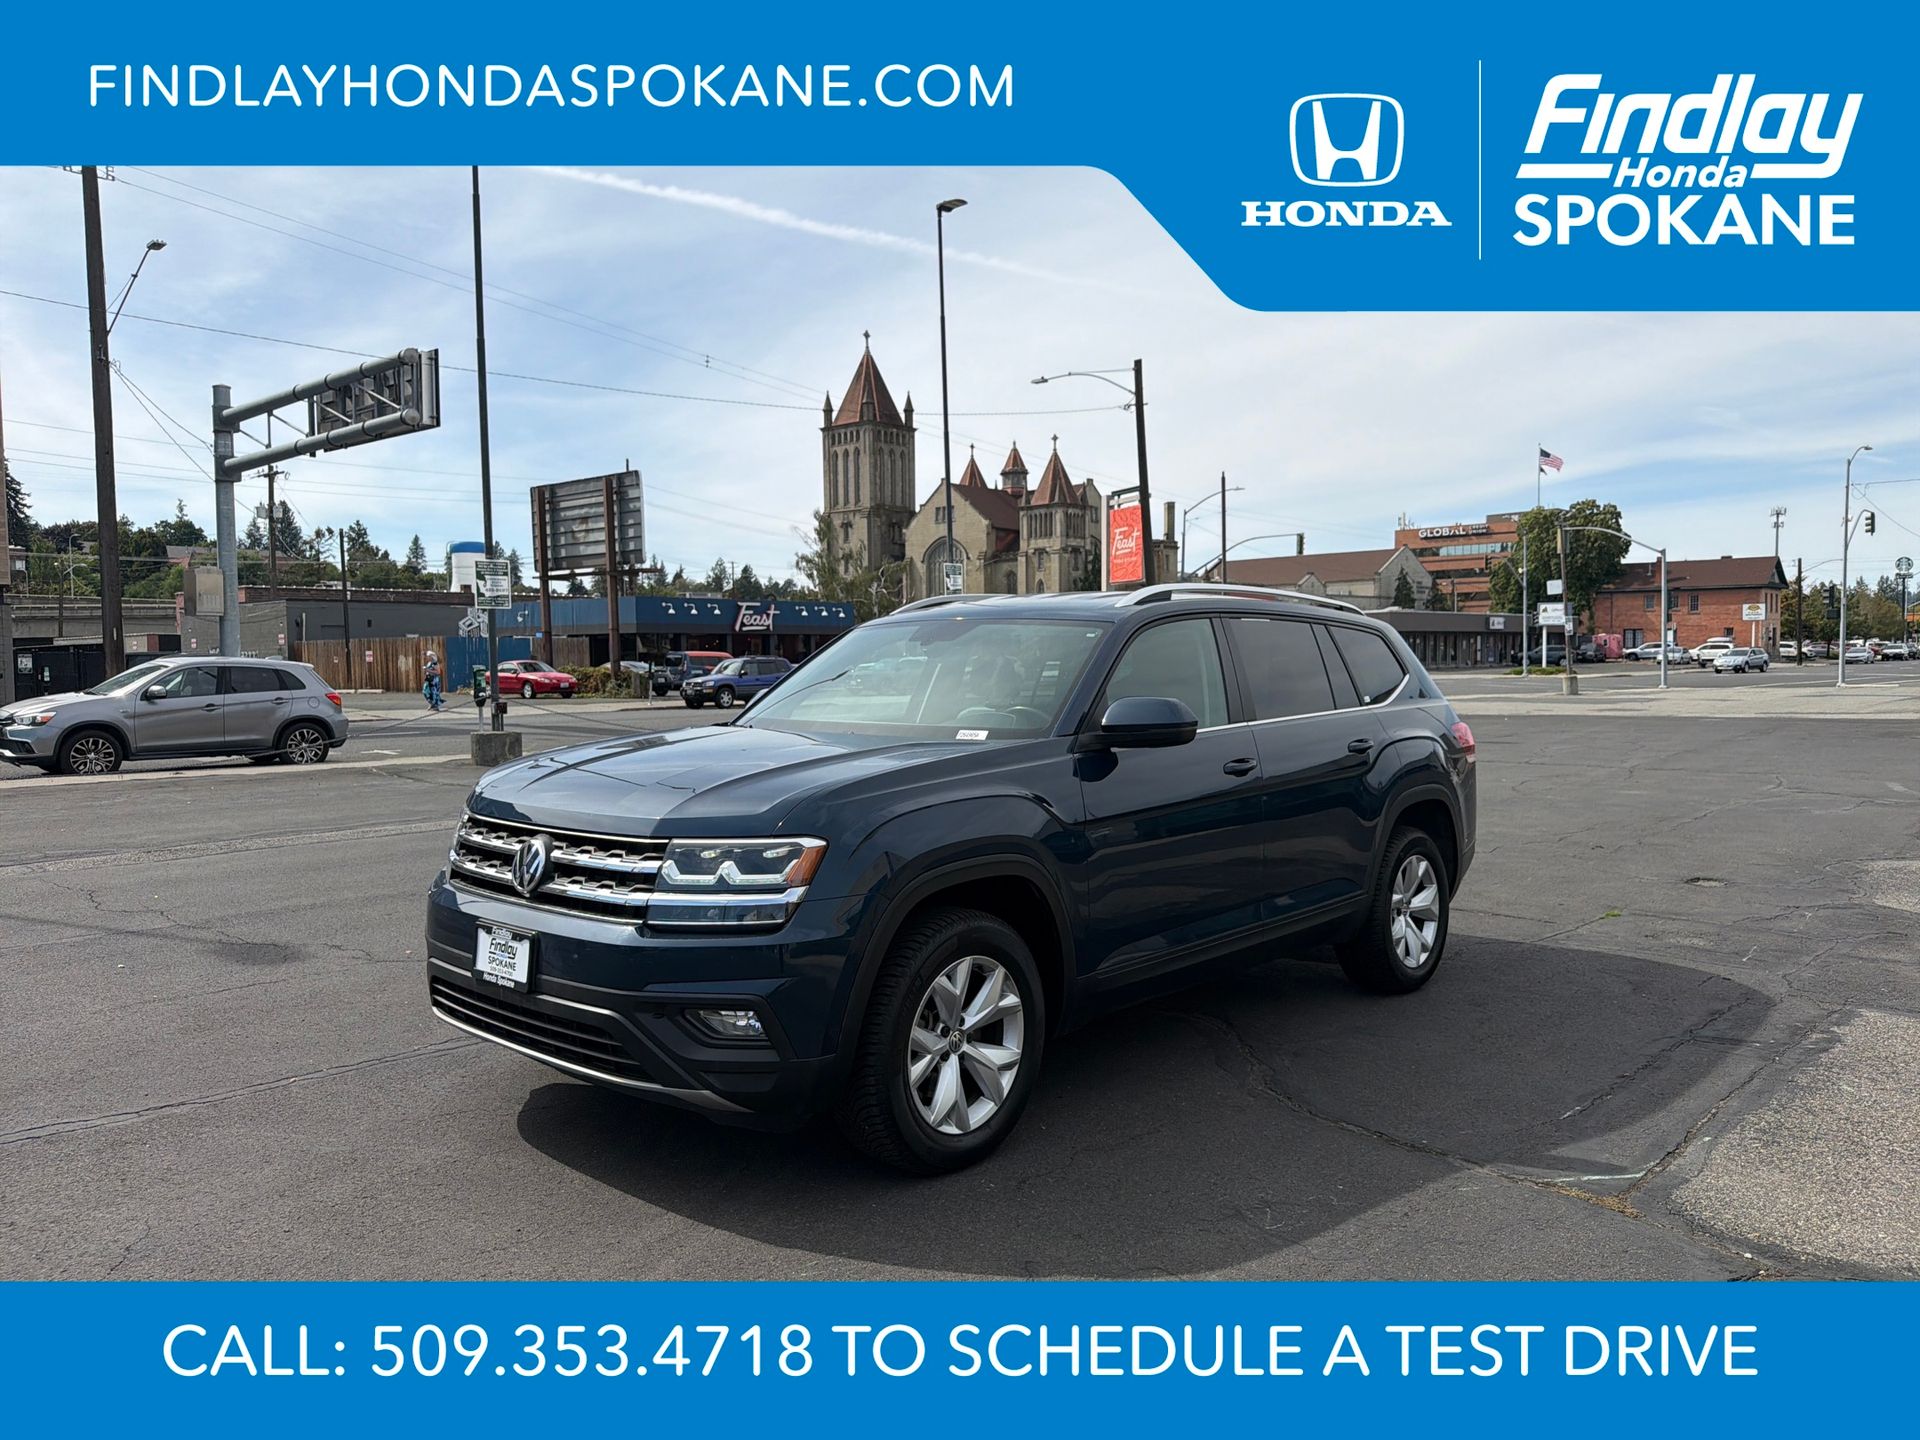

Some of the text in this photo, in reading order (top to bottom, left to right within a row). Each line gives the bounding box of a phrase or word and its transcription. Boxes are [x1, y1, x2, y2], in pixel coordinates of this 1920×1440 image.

[1112, 526, 1140, 556] Feast
[1418, 526, 1467, 538] GLOBAL
[735, 601, 780, 632] Feast
[489, 938, 517, 959] Findlay
[488, 956, 516, 971] SPOKANE
[483, 972, 497, 982] Honda
